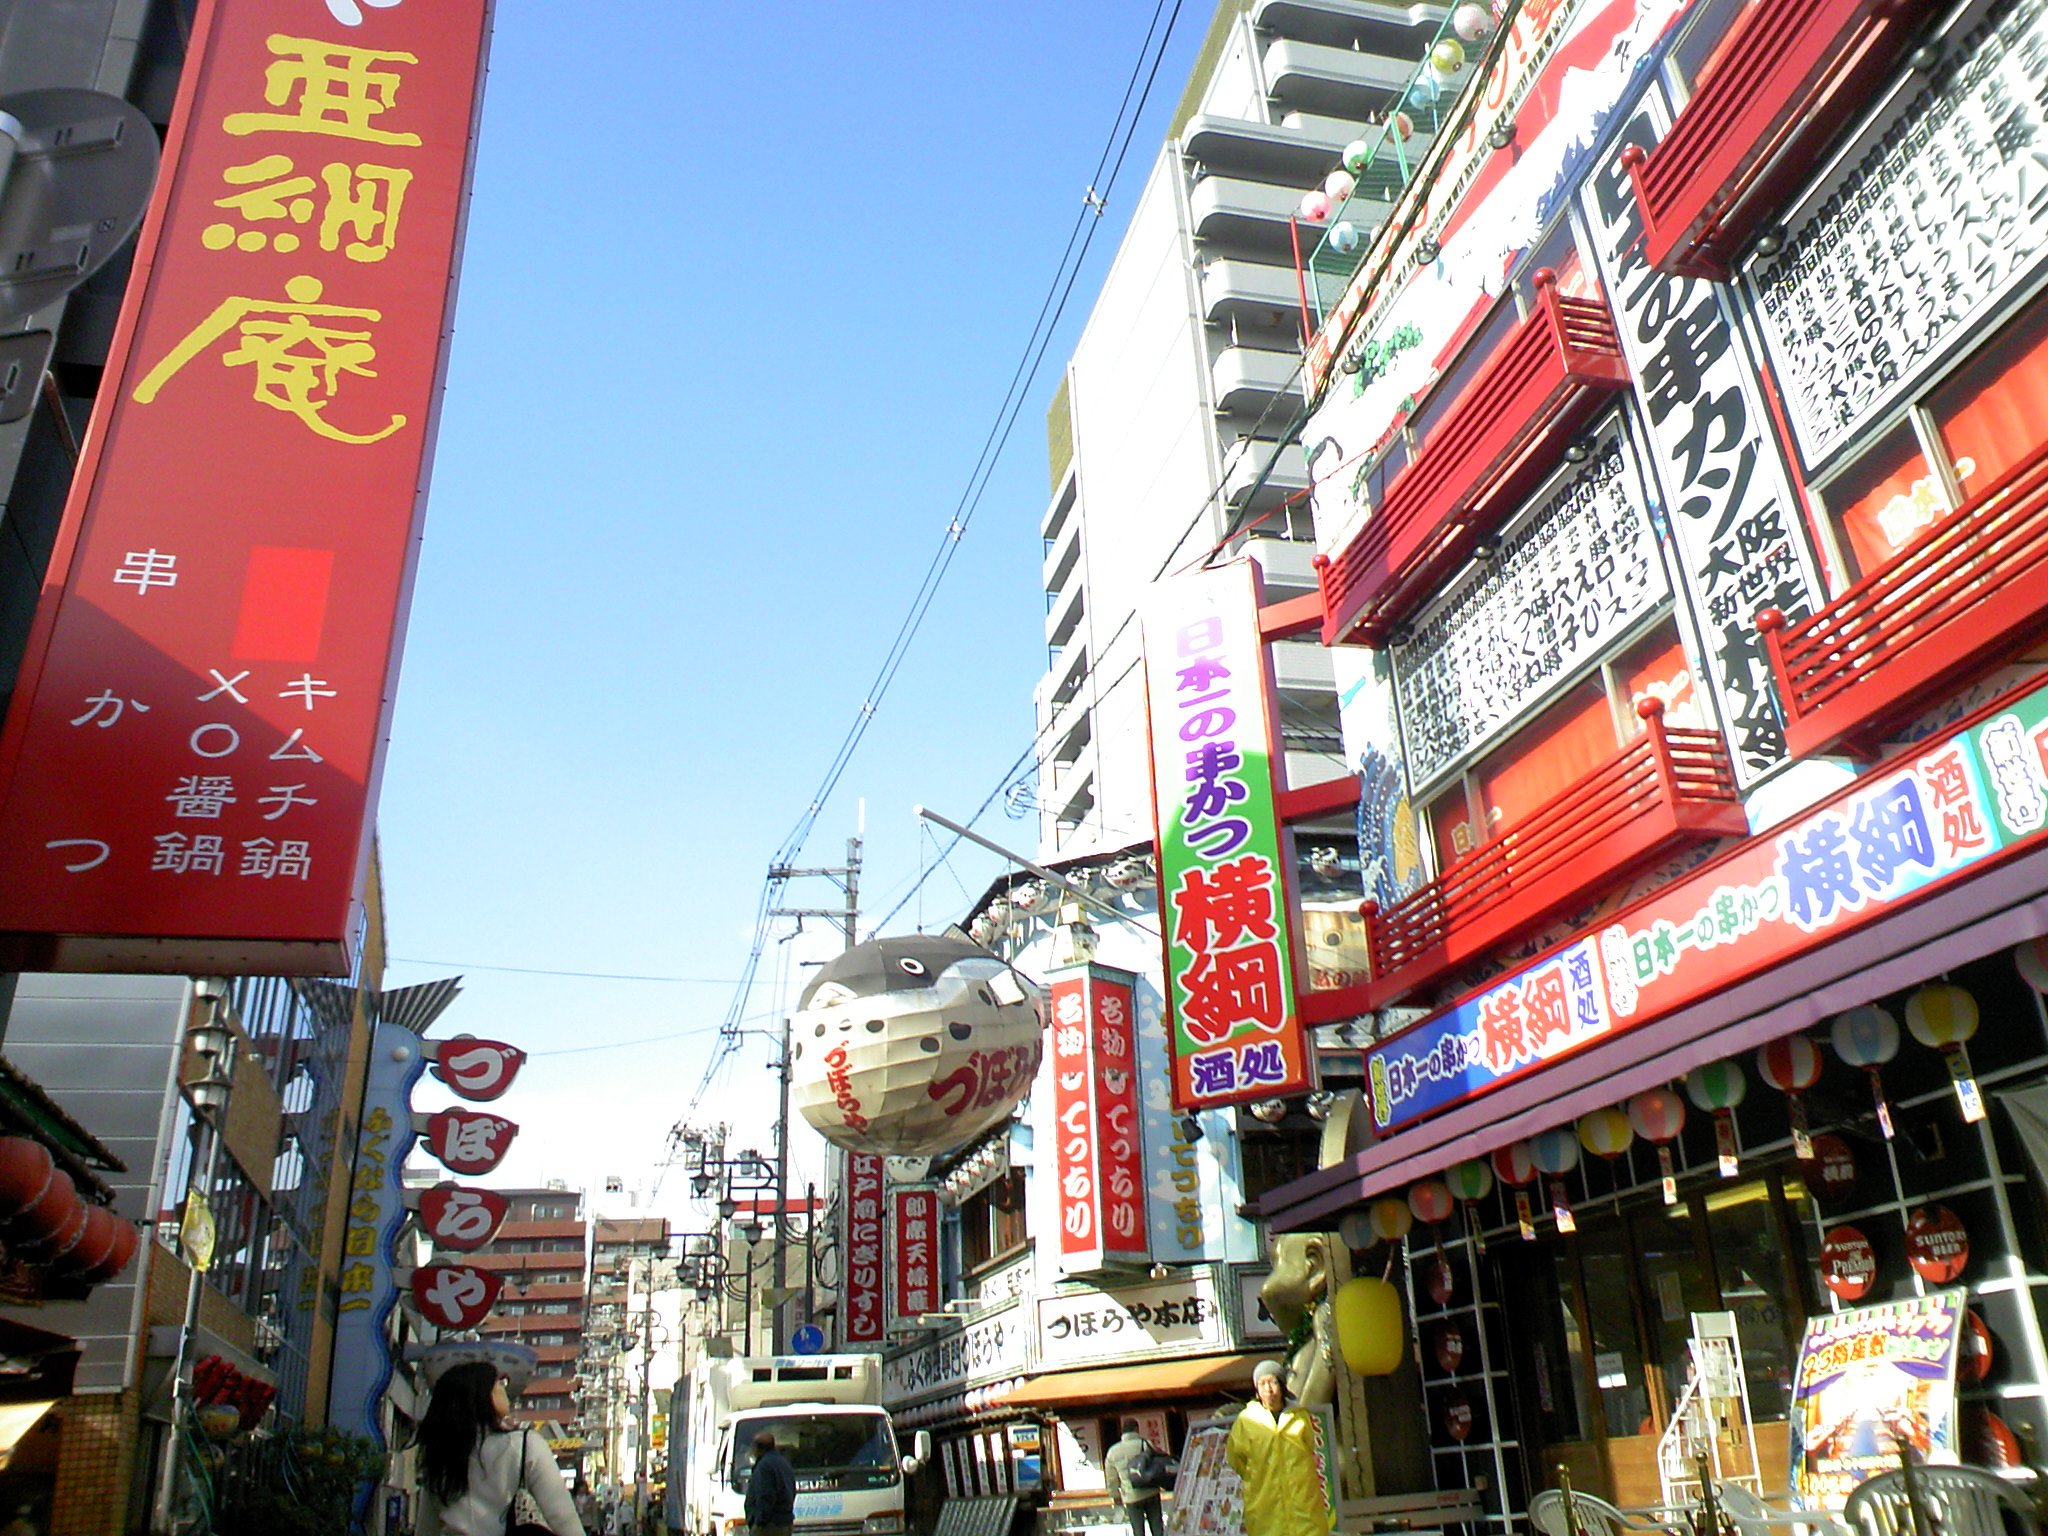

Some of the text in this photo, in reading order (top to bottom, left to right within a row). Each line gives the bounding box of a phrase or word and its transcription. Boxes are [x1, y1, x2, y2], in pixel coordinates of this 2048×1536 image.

[1890, 208, 1957, 354] 紅しょうが
[1915, 189, 1973, 327] しゅうまい
[1846, 266, 1898, 394] 本日の白身
[1569, 553, 1605, 638] えび
[1588, 531, 1626, 625] 豚ロース
[1698, 497, 1786, 596] 大阪
[1710, 542, 1798, 626] 新世界
[1512, 604, 1544, 688] つくね
[1549, 571, 1583, 655] 穴子
[240, 673, 337, 880] キムチ鍋
[1175, 616, 1250, 856] 日本一の串かつ
[1634, 884, 1779, 976] 日本一の串かつ
[1780, 777, 1936, 926] 横綱
[1924, 750, 1985, 858] 酒処
[1175, 856, 1281, 1040] 横綱
[1193, 1044, 1284, 1093] 酒処
[1388, 1034, 1480, 1100] 日本一の串かつ
[1483, 960, 1571, 1066] 横綱
[1570, 948, 1600, 1029] 酒処
[425, 1046, 517, 1322] づぼらや
[1060, 1101, 1092, 1238] てっちり
[1105, 1104, 1136, 1237] てっちり
[1915, 1231, 1967, 1247] SUNTORY
[795, 1479, 838, 1490] ISUZU
[1015, 1434, 1036, 1442] VISA
